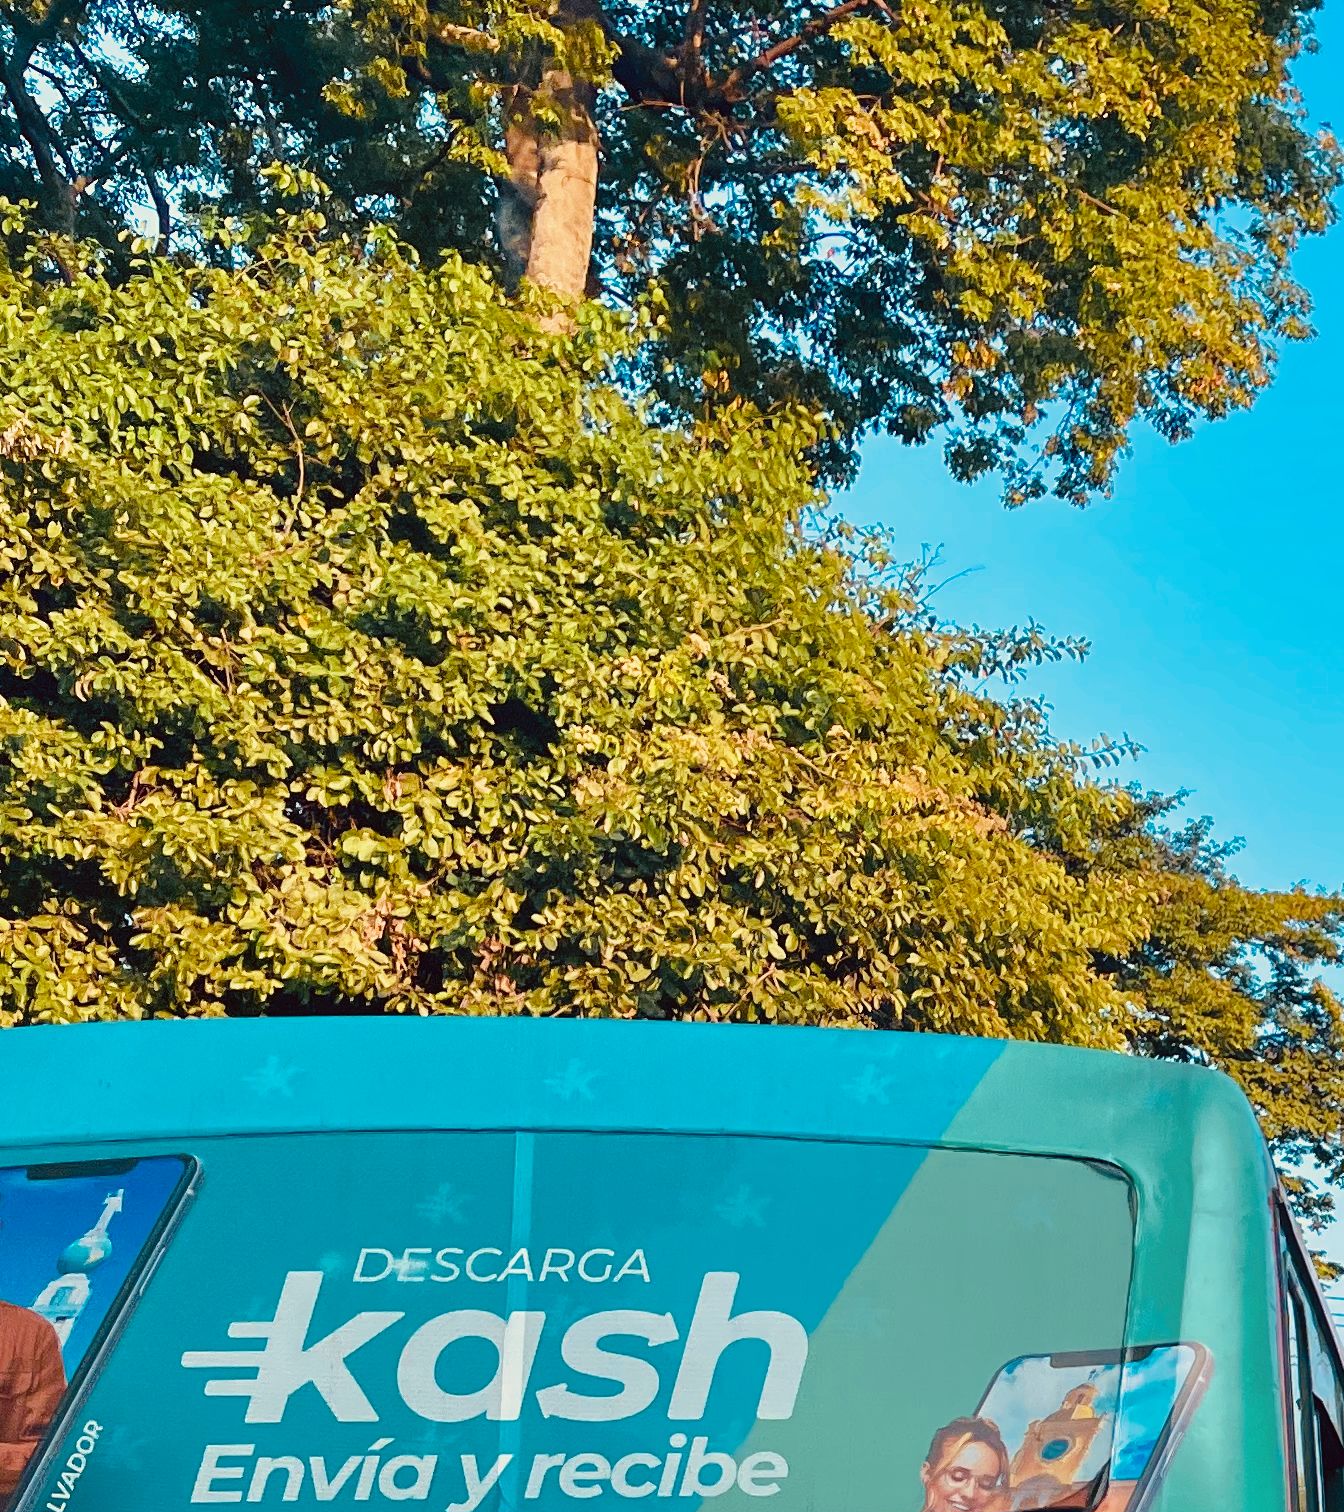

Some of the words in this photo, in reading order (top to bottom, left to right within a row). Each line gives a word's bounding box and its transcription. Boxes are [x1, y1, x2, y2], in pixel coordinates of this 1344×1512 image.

[353, 1247, 652, 1284] DESCARGA
[181, 1270, 810, 1425] kash
[190, 1438, 433, 1505] Envía
[525, 1433, 789, 1498] recibe
